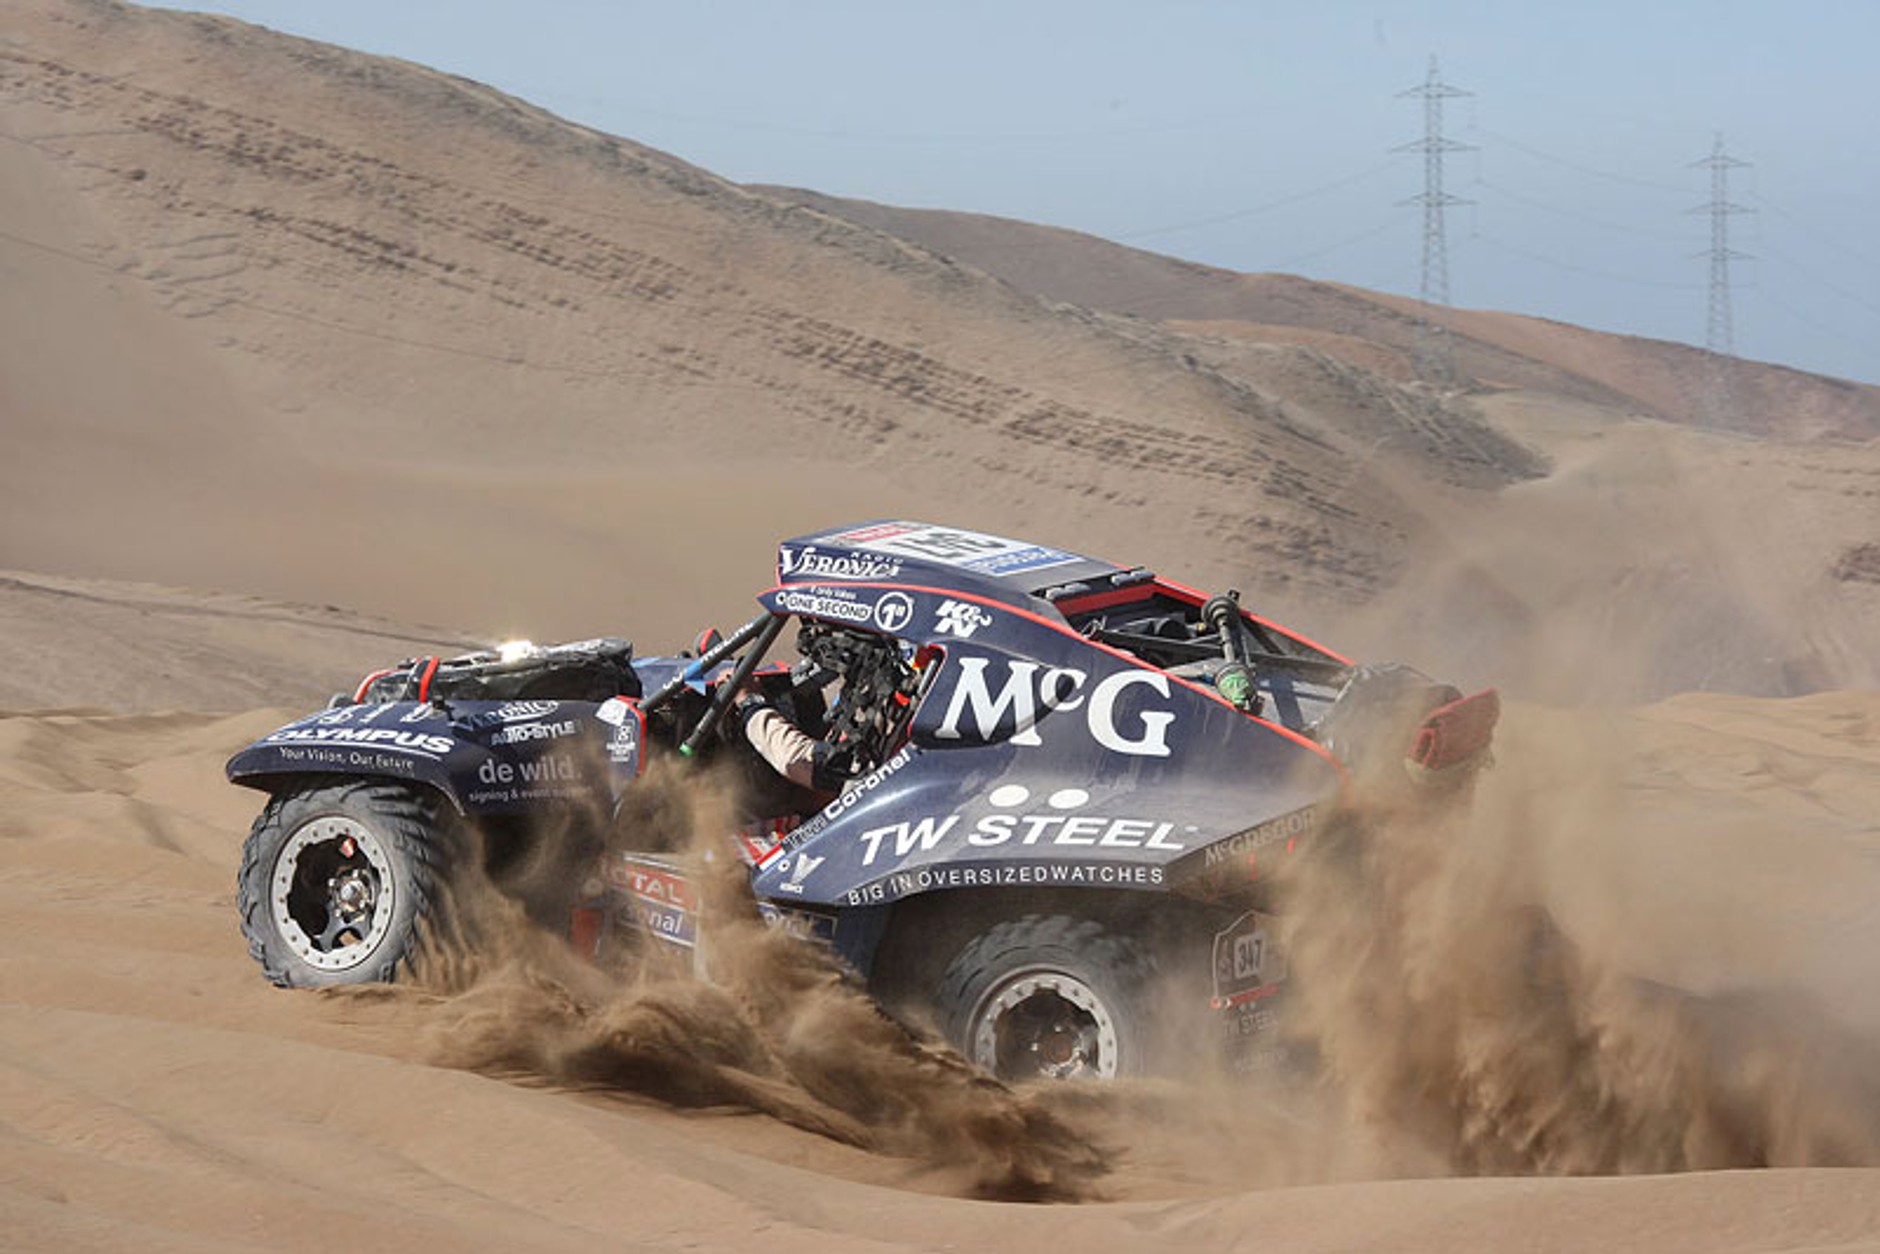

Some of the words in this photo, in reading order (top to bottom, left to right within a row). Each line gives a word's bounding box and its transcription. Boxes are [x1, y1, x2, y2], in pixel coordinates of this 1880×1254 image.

[787, 594, 816, 612] ONE
[816, 597, 870, 620] SECOND
[267, 728, 455, 753] OLYMPUS
[279, 746, 305, 760] Your
[350, 752, 374, 765] Our
[375, 755, 415, 770] Future
[479, 758, 514, 784] de
[823, 748, 911, 821] Coronel
[860, 816, 960, 866] TW
[967, 814, 1186, 851] STEEL
[848, 878, 884, 906] BIG
[890, 874, 912, 894] IN
[1237, 938, 1263, 975] 347
